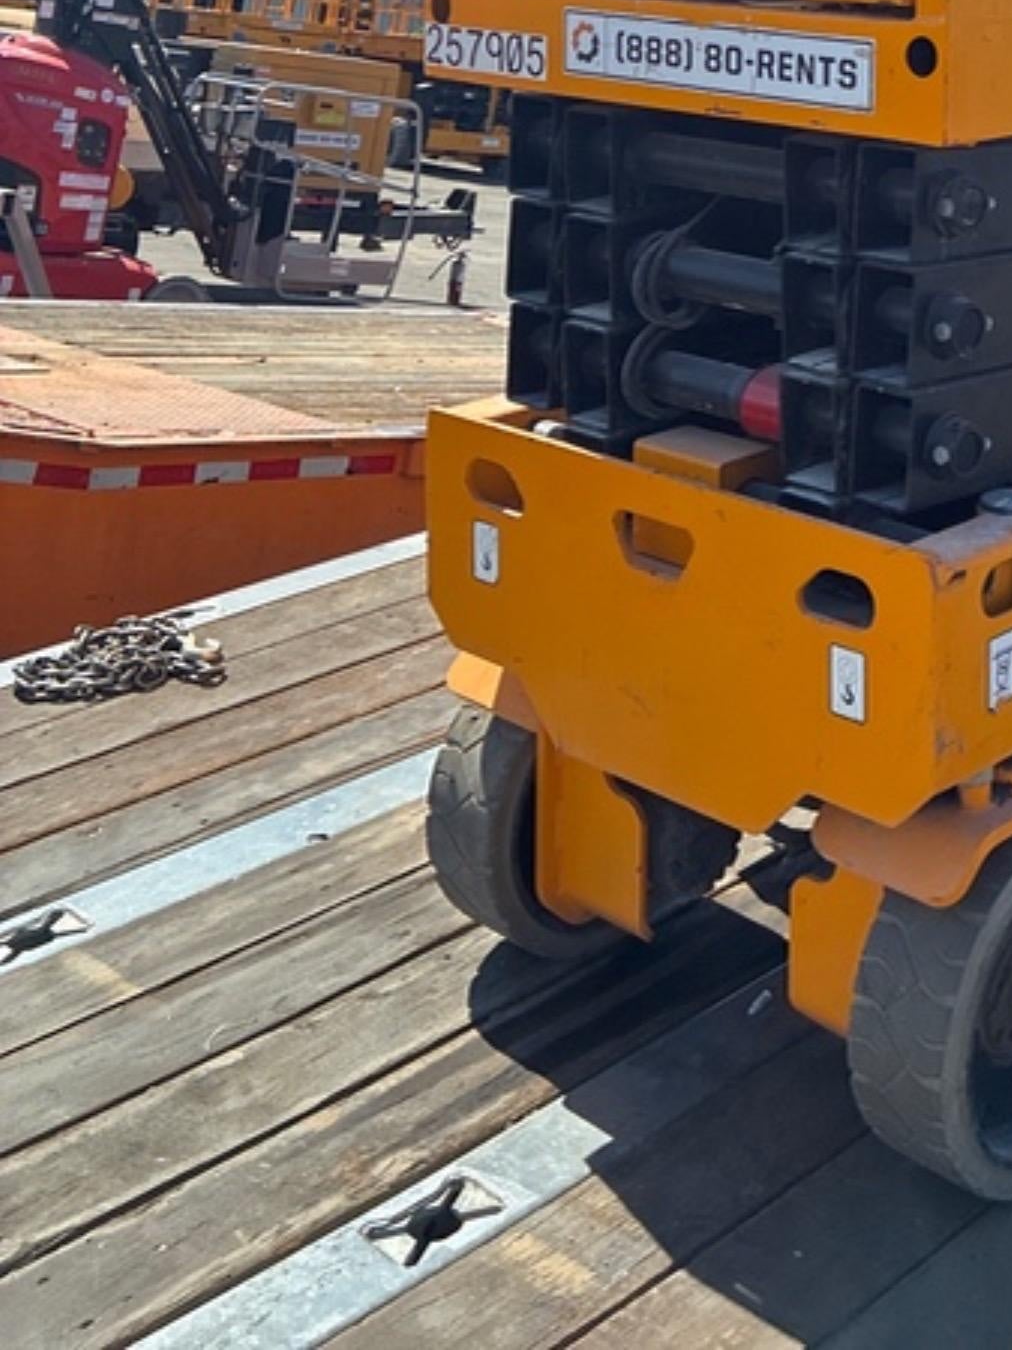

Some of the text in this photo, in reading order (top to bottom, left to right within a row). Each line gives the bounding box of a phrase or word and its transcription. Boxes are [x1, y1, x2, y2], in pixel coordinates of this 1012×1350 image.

[427, 23, 545, 77] 257905
[616, 30, 858, 90] (888) 80-RENTS
